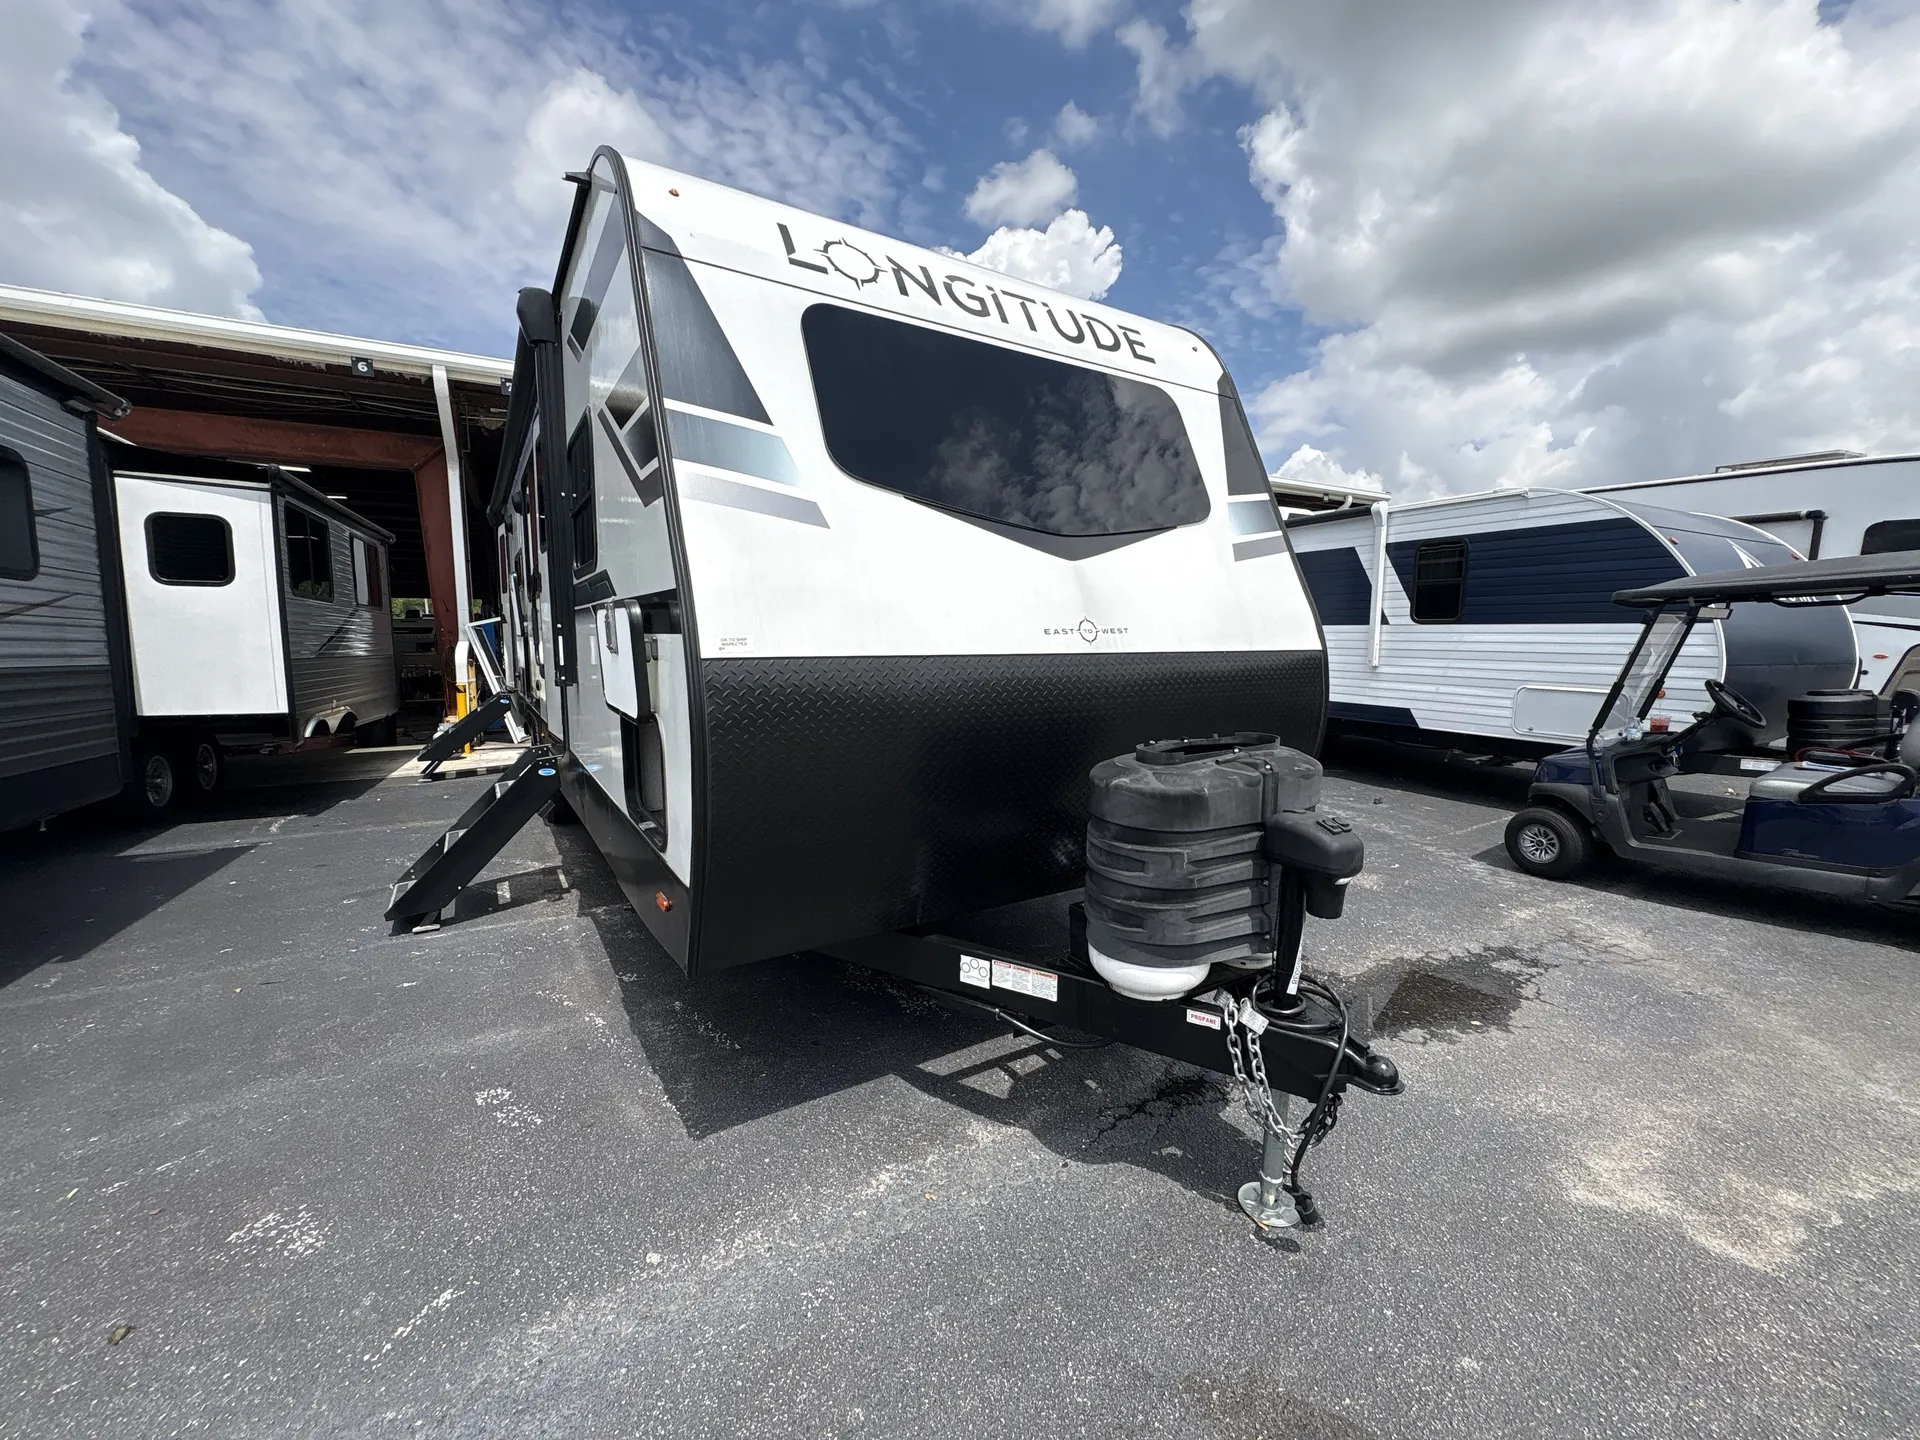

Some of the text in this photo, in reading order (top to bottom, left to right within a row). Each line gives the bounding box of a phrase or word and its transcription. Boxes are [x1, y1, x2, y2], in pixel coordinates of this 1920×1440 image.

[357, 361, 369, 373] 6
[1100, 627, 1128, 635] WEST
[1190, 1013, 1217, 1025] PROPANE
